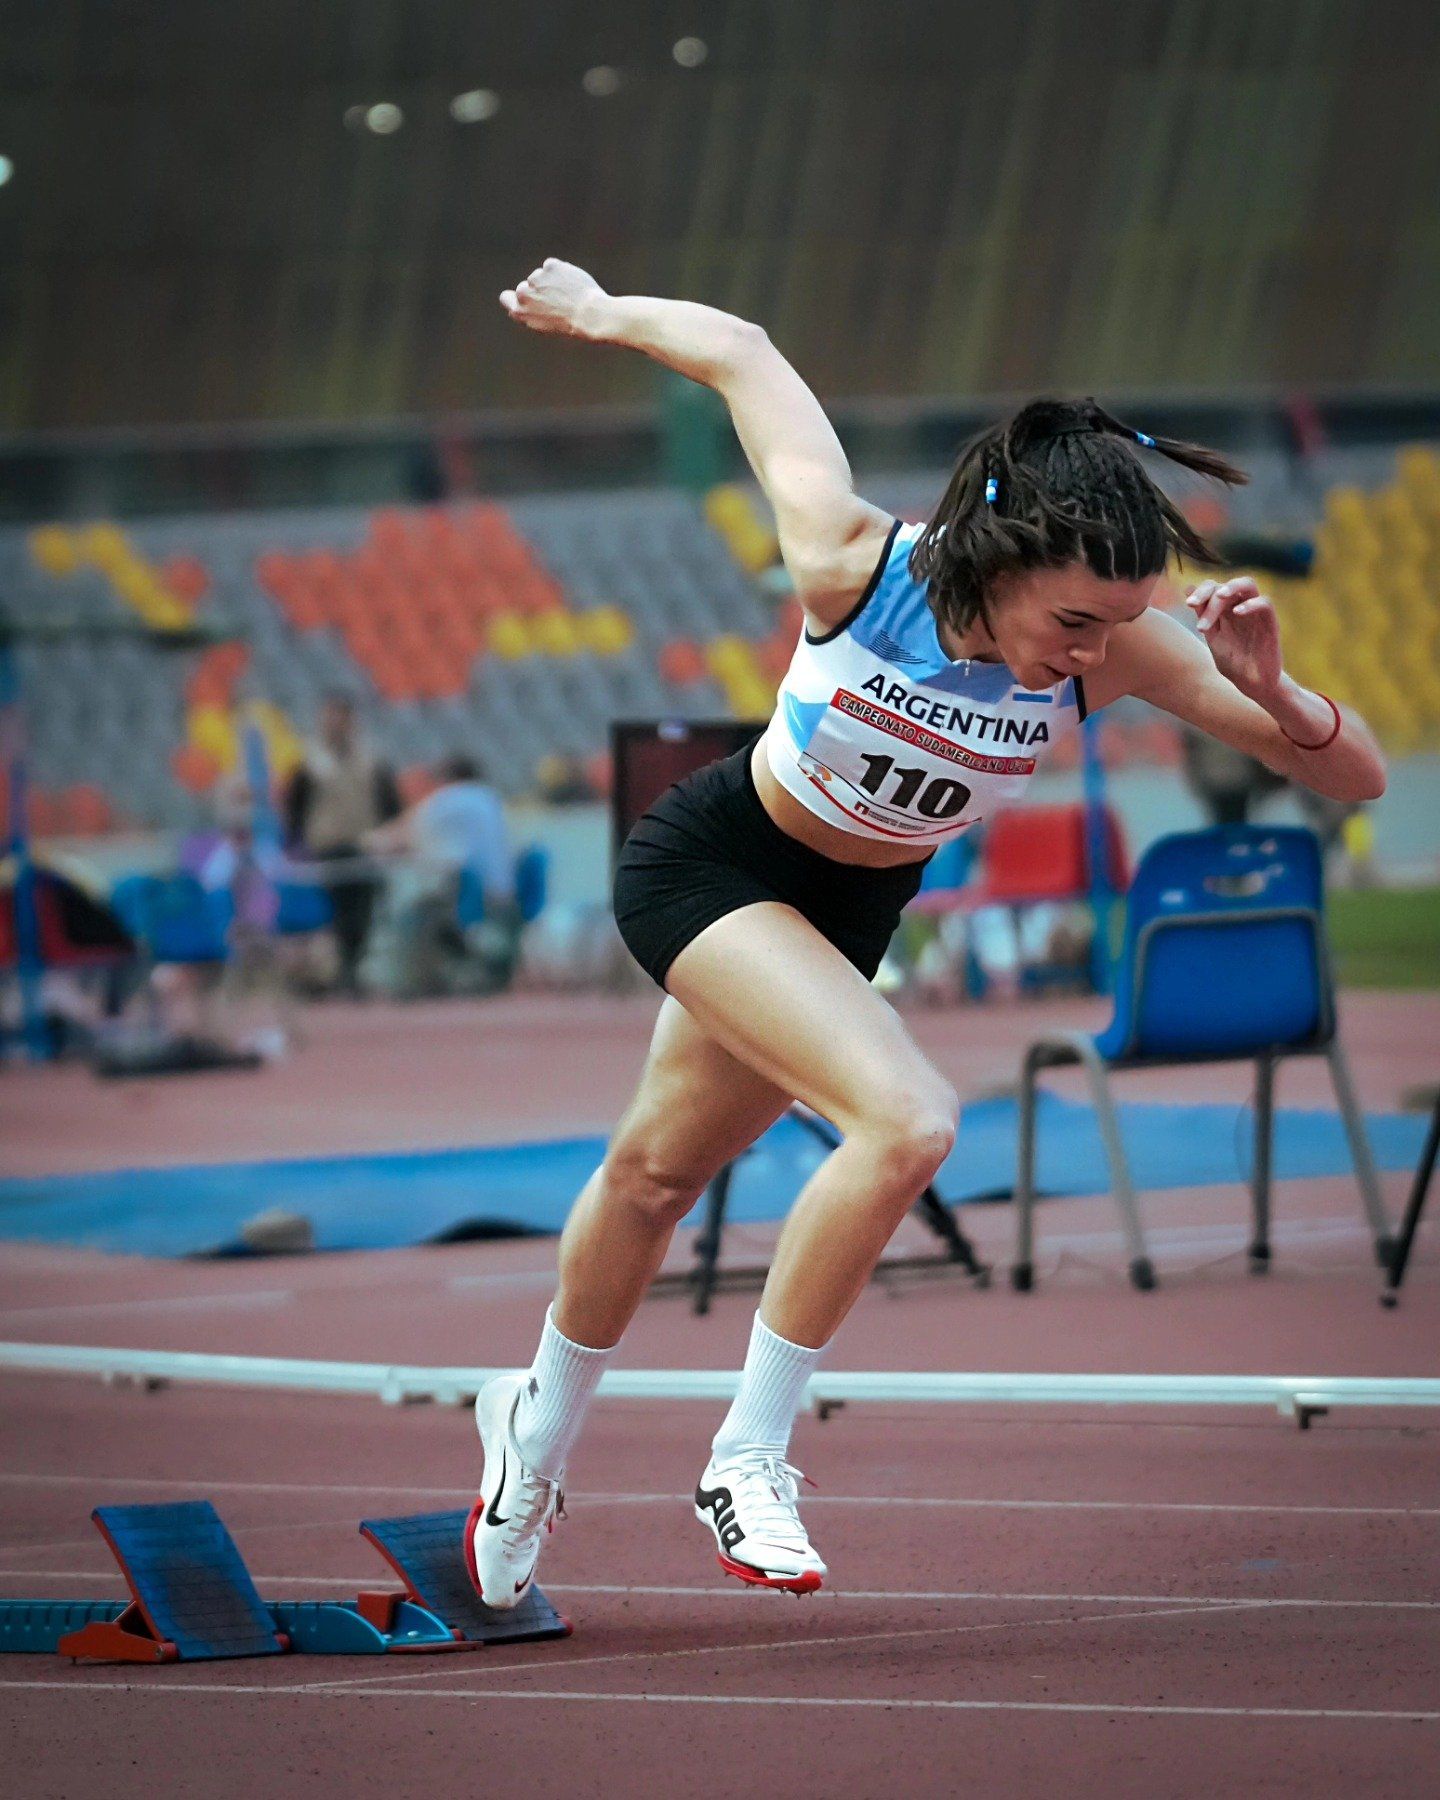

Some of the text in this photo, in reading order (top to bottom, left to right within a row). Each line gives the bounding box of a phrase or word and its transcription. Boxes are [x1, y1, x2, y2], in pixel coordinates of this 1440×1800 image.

[839, 694, 916, 740] CAMPEONATO
[916, 731, 1004, 772] SUDAMERICANO
[861, 673, 1049, 745] ARGENTINA
[860, 752, 972, 818] 110
